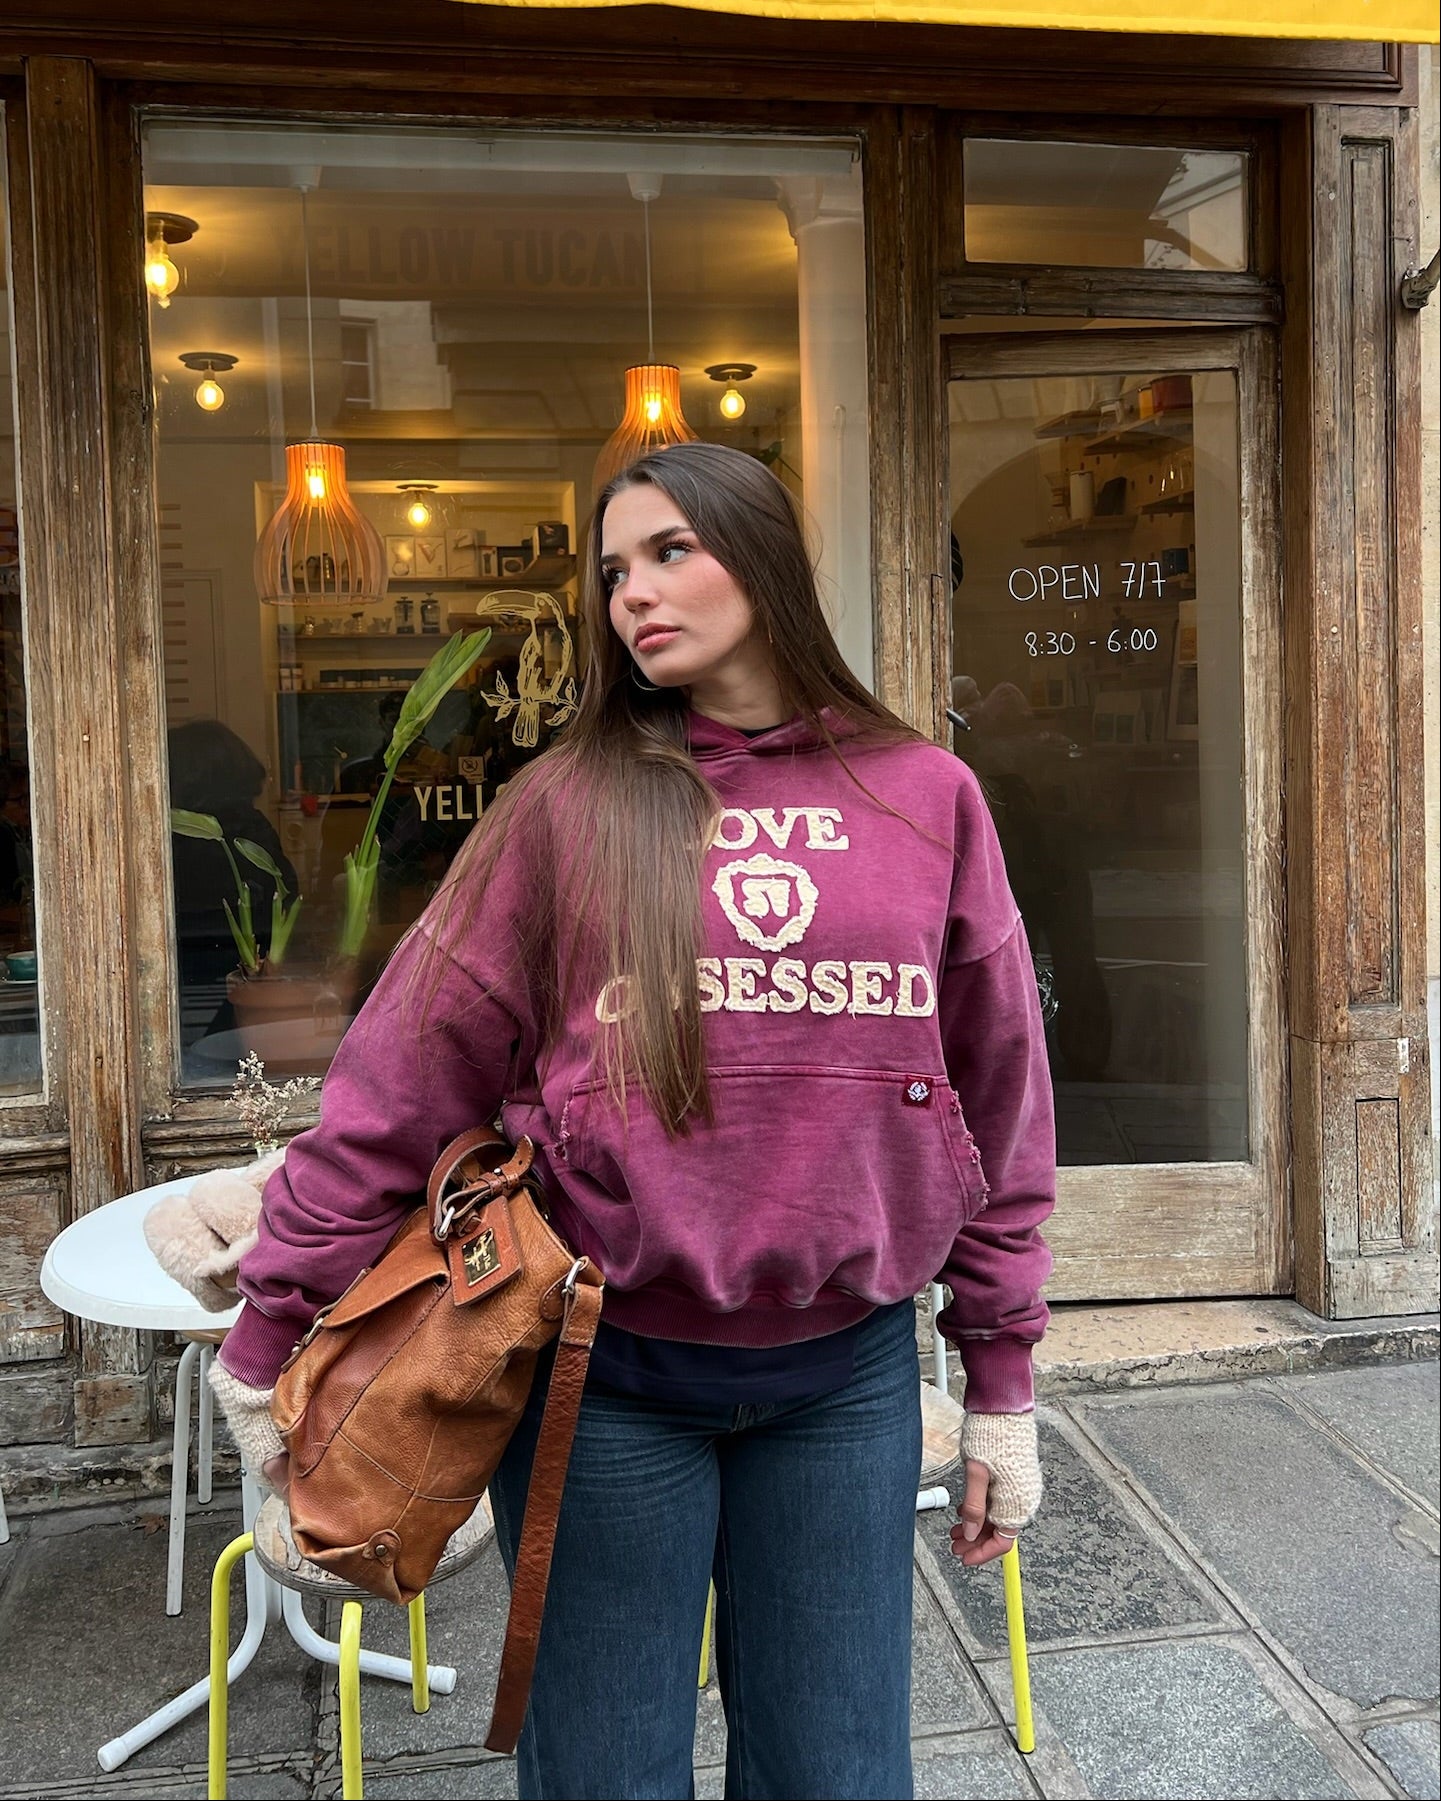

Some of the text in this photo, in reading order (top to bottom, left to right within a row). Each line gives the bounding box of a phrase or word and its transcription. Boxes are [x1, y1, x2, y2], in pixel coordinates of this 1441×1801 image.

[1008, 561, 1167, 602] OPEN 7/7
[1024, 631, 1077, 657] 8:30
[1107, 628, 1158, 653] 6:00
[413, 783, 507, 822] YELL
[706, 806, 850, 851] OVE
[594, 956, 937, 1024] OSESSED
